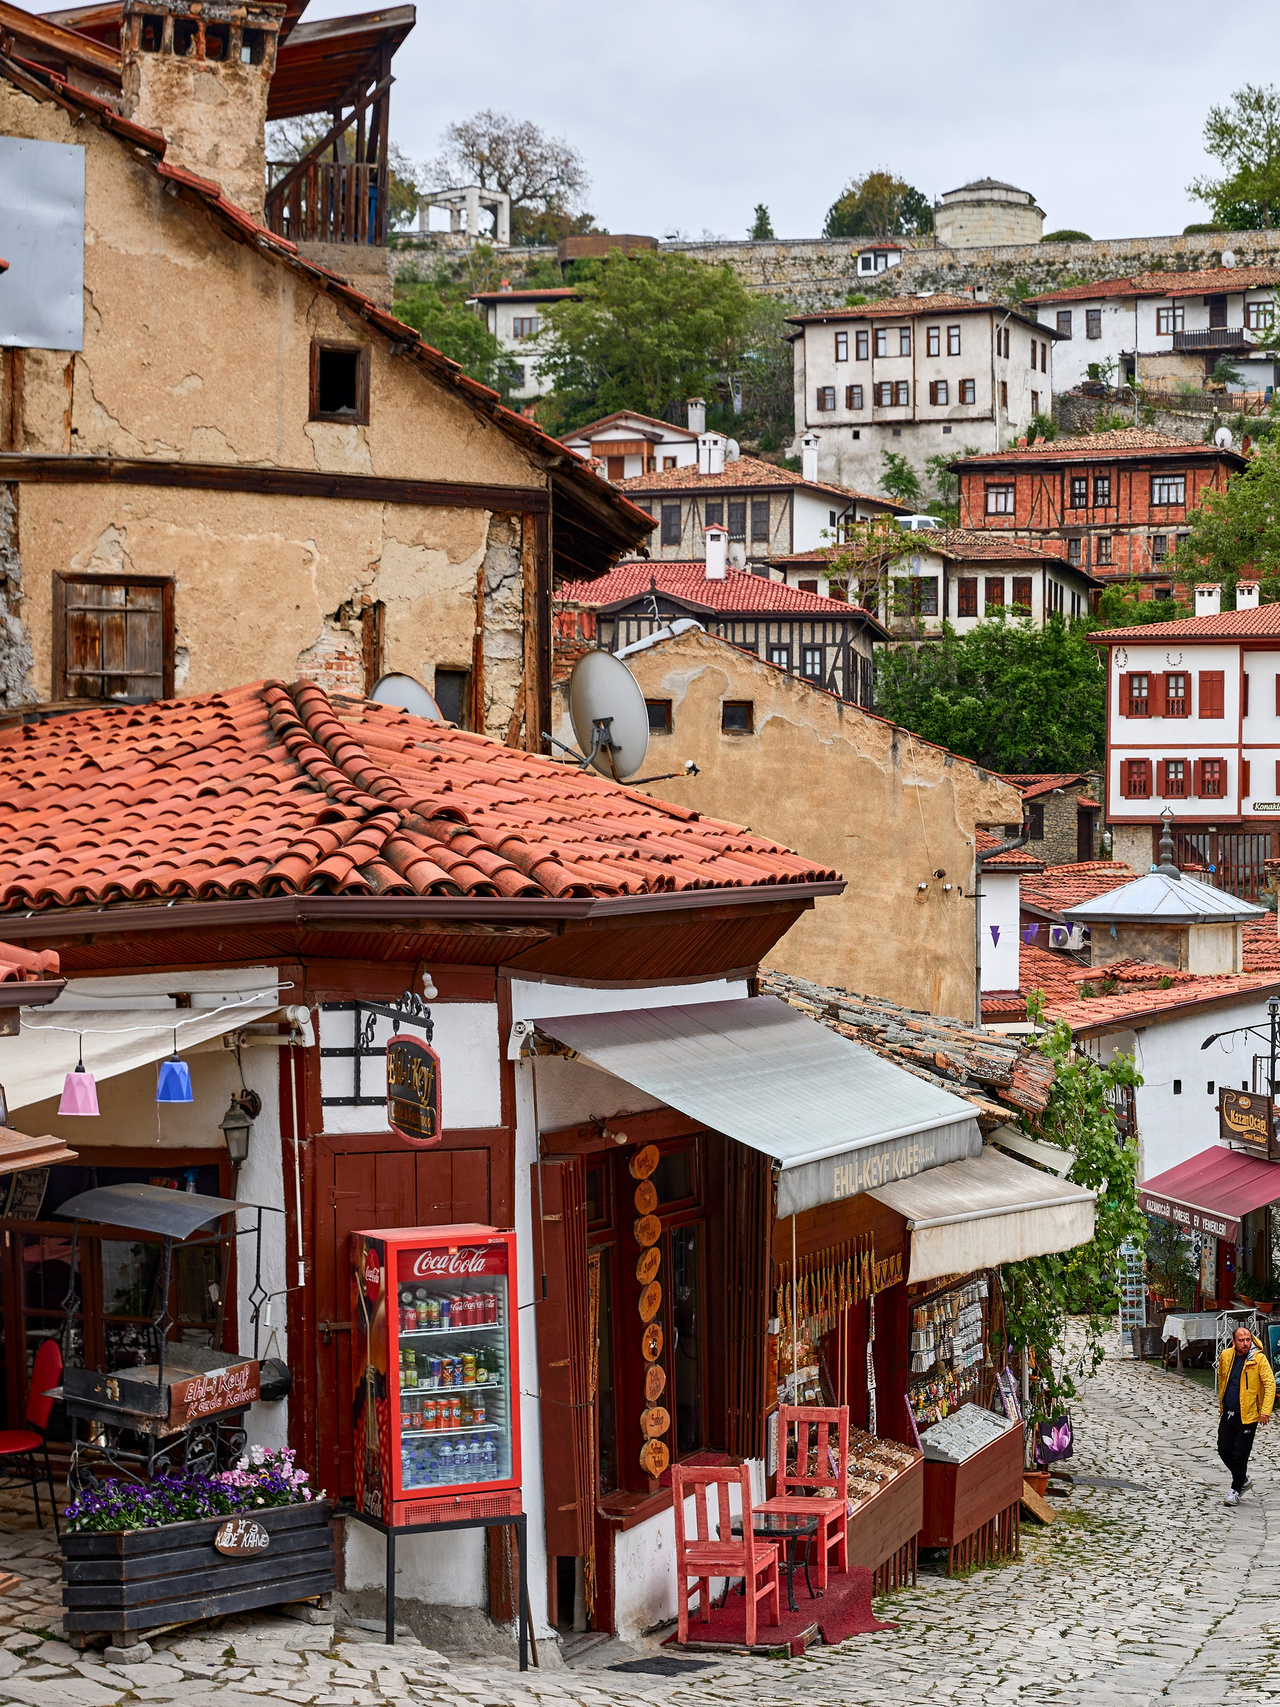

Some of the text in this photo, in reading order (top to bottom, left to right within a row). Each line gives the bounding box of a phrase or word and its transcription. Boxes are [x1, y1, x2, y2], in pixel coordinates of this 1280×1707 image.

[892, 1144, 919, 1179] KAFE
[1193, 1214, 1200, 1227] EV
[413, 1246, 490, 1276] Coca-Cola
